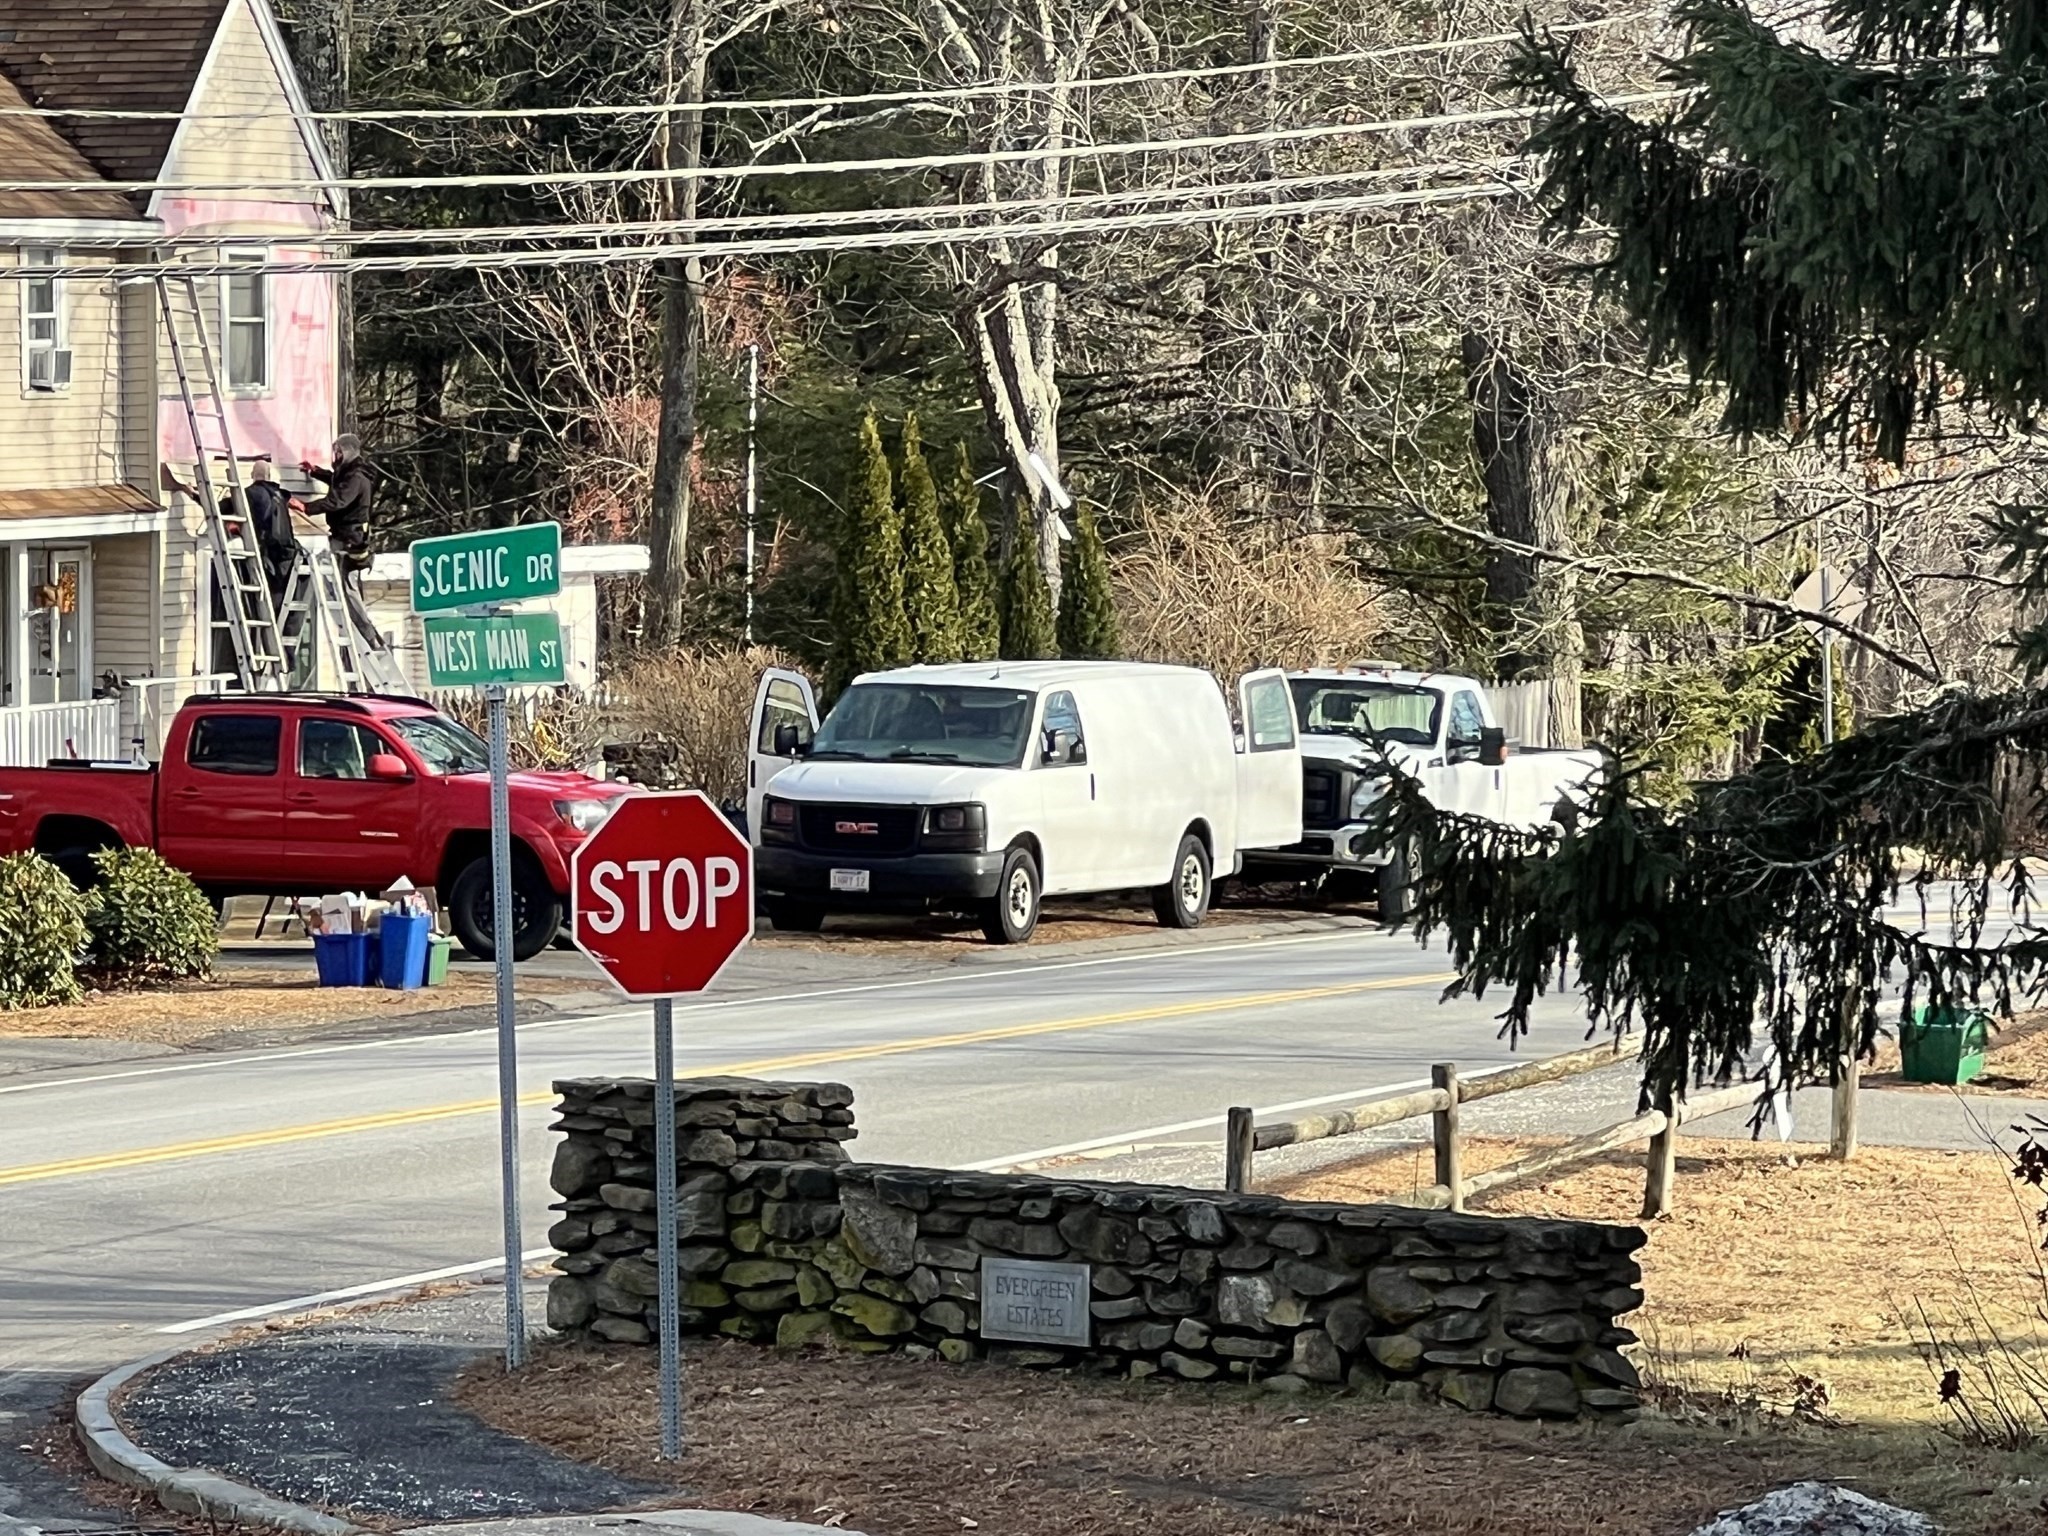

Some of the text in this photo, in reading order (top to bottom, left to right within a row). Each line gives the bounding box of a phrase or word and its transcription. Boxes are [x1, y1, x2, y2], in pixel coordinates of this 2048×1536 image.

[419, 546, 553, 597] SCENIC DR
[430, 629, 557, 672] WEST MAIN ST
[835, 821, 878, 834] GMC
[587, 857, 740, 934] STOP
[996, 1275, 1075, 1300] EVERGREEN
[1007, 1304, 1063, 1328] ESTATES
